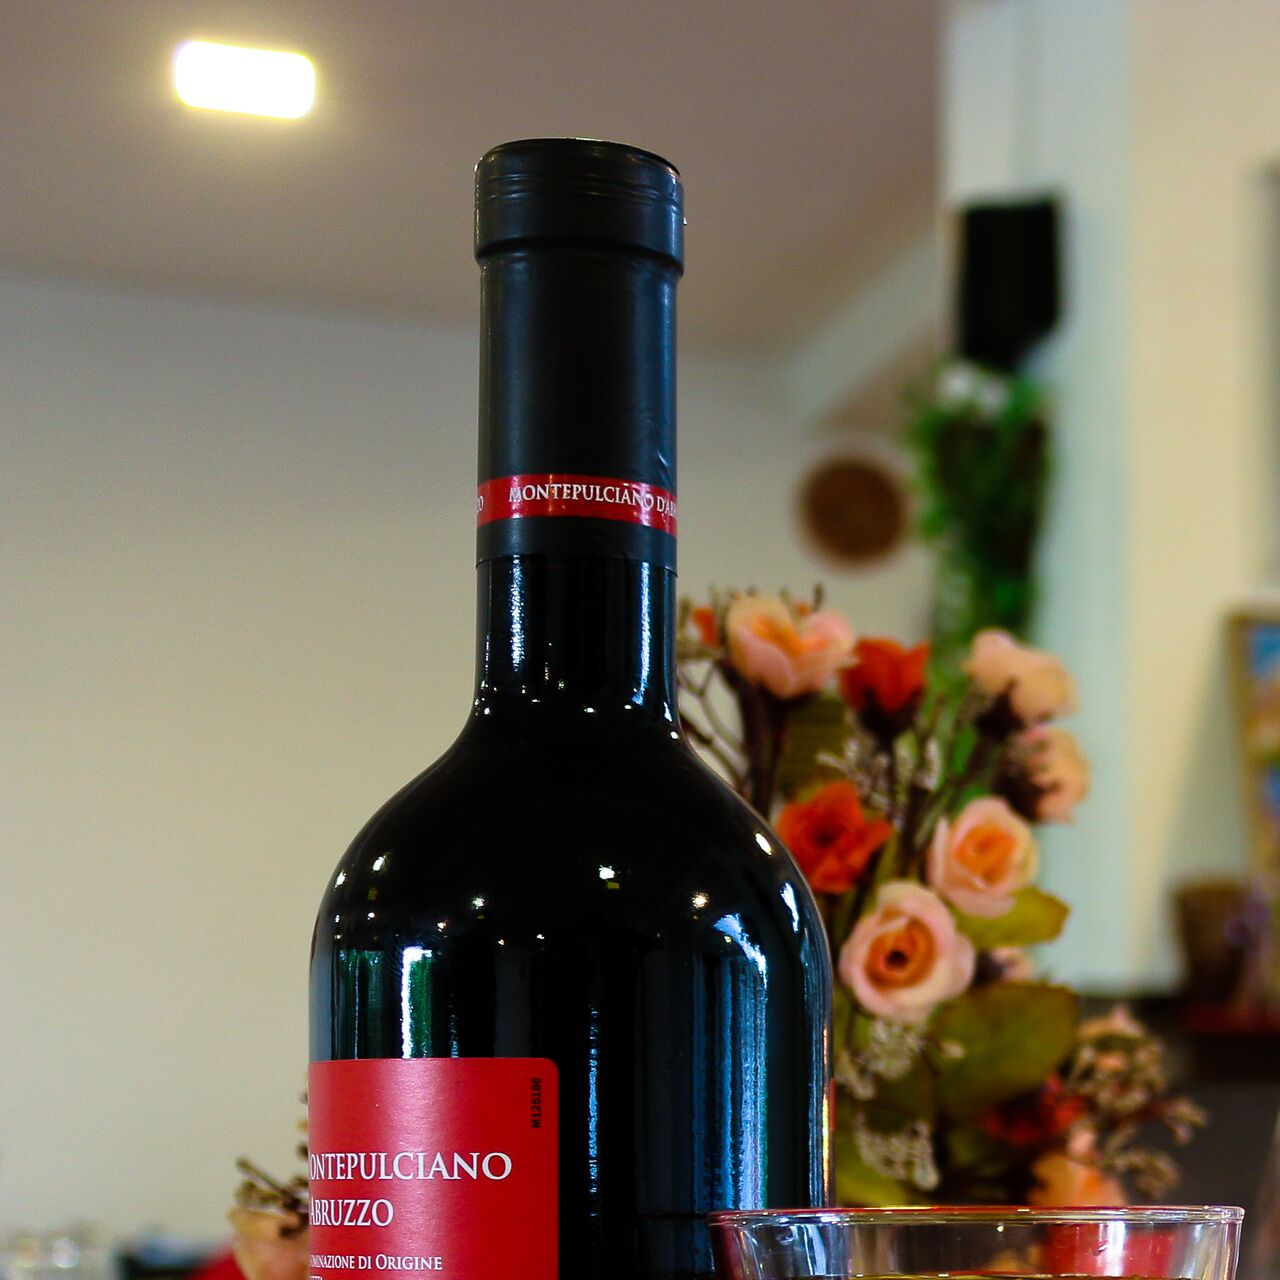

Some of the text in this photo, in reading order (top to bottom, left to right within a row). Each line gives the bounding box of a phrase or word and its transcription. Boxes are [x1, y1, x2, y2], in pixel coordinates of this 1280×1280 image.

[509, 483, 655, 511] MONTEPULCIANO
[309, 1152, 513, 1180] ONTEPULCIANO
[309, 1198, 395, 1226] ABRUZZO
[358, 1255, 372, 1270] DI
[375, 1253, 443, 1270] ORIGINE
